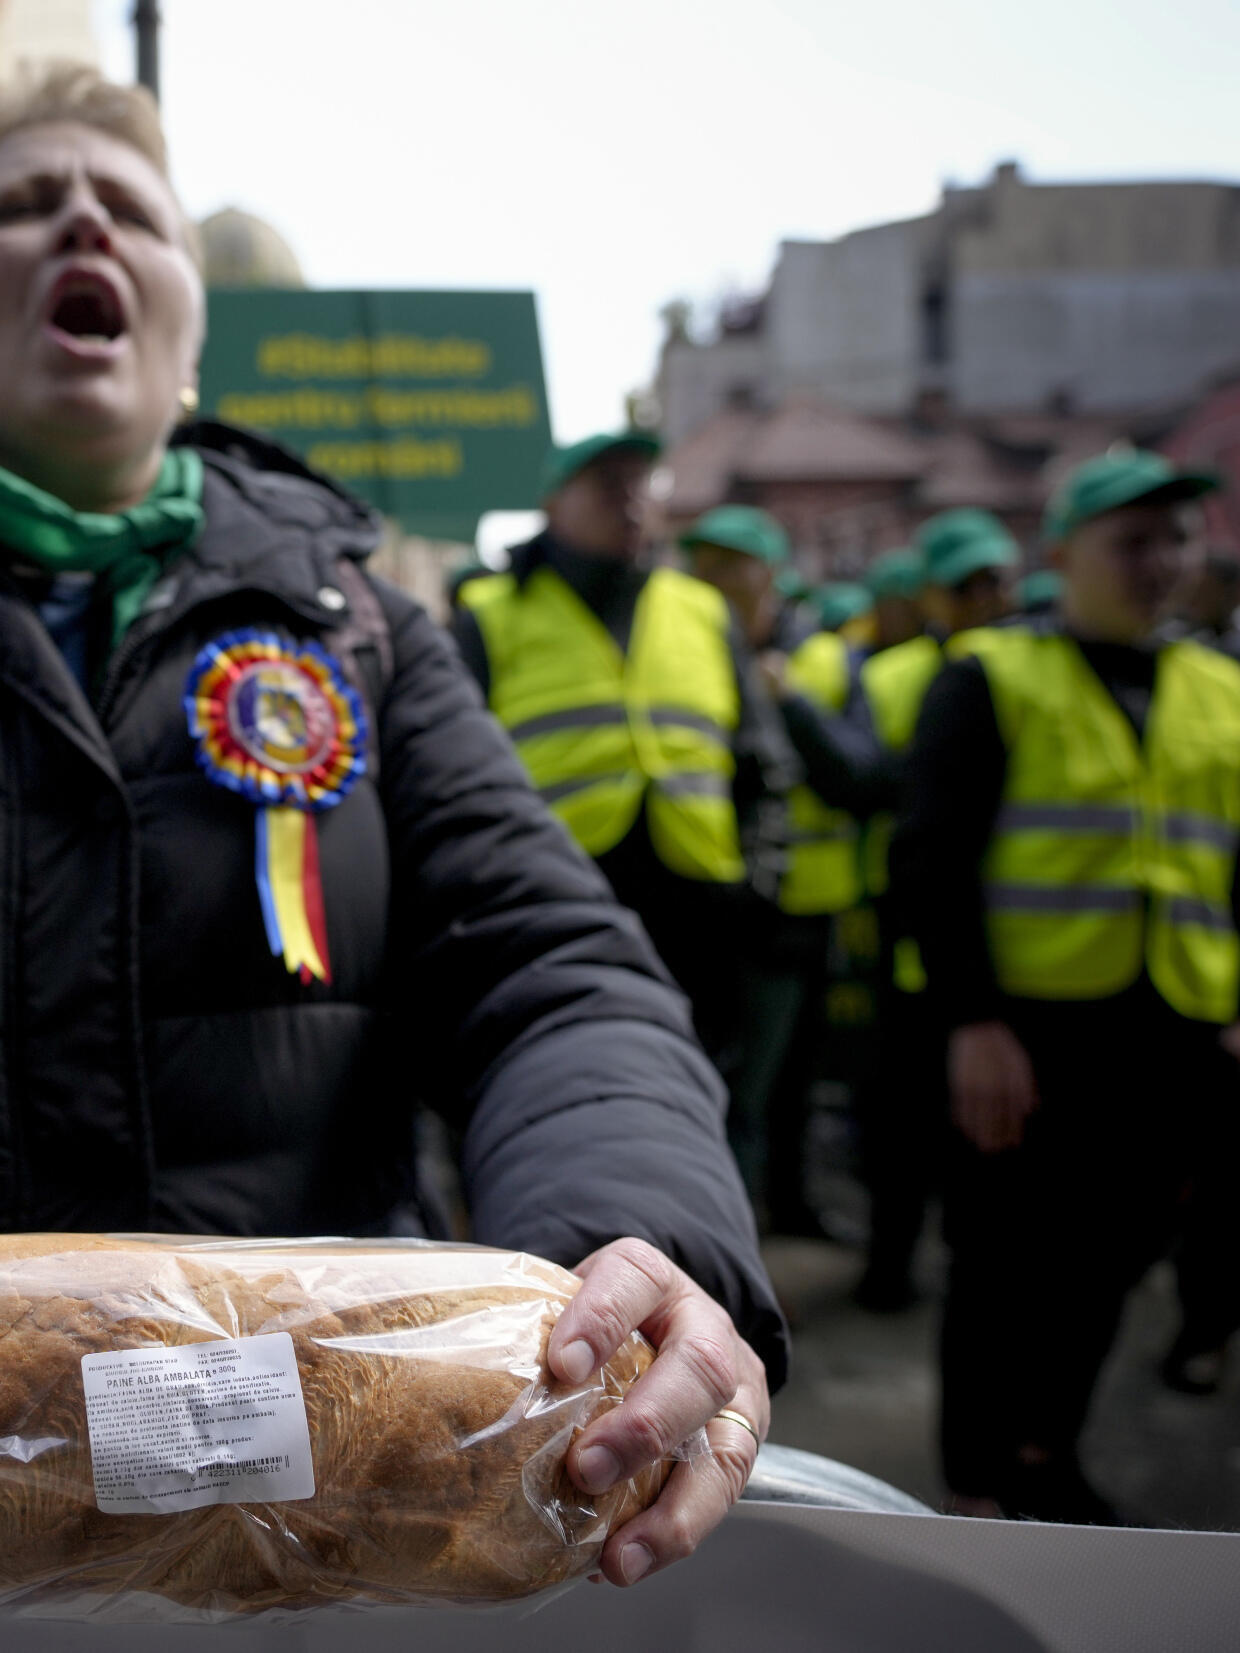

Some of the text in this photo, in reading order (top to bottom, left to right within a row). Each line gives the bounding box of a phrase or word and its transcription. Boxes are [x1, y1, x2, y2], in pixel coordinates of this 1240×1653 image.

[106, 1377, 134, 1389] PAINE
[137, 1374, 160, 1385] ALBA
[163, 1369, 211, 1382] AMBALATA
[218, 1365, 236, 1374] 300g
[207, 1468, 241, 1478] 422311
[246, 1464, 281, 1475] 204016
